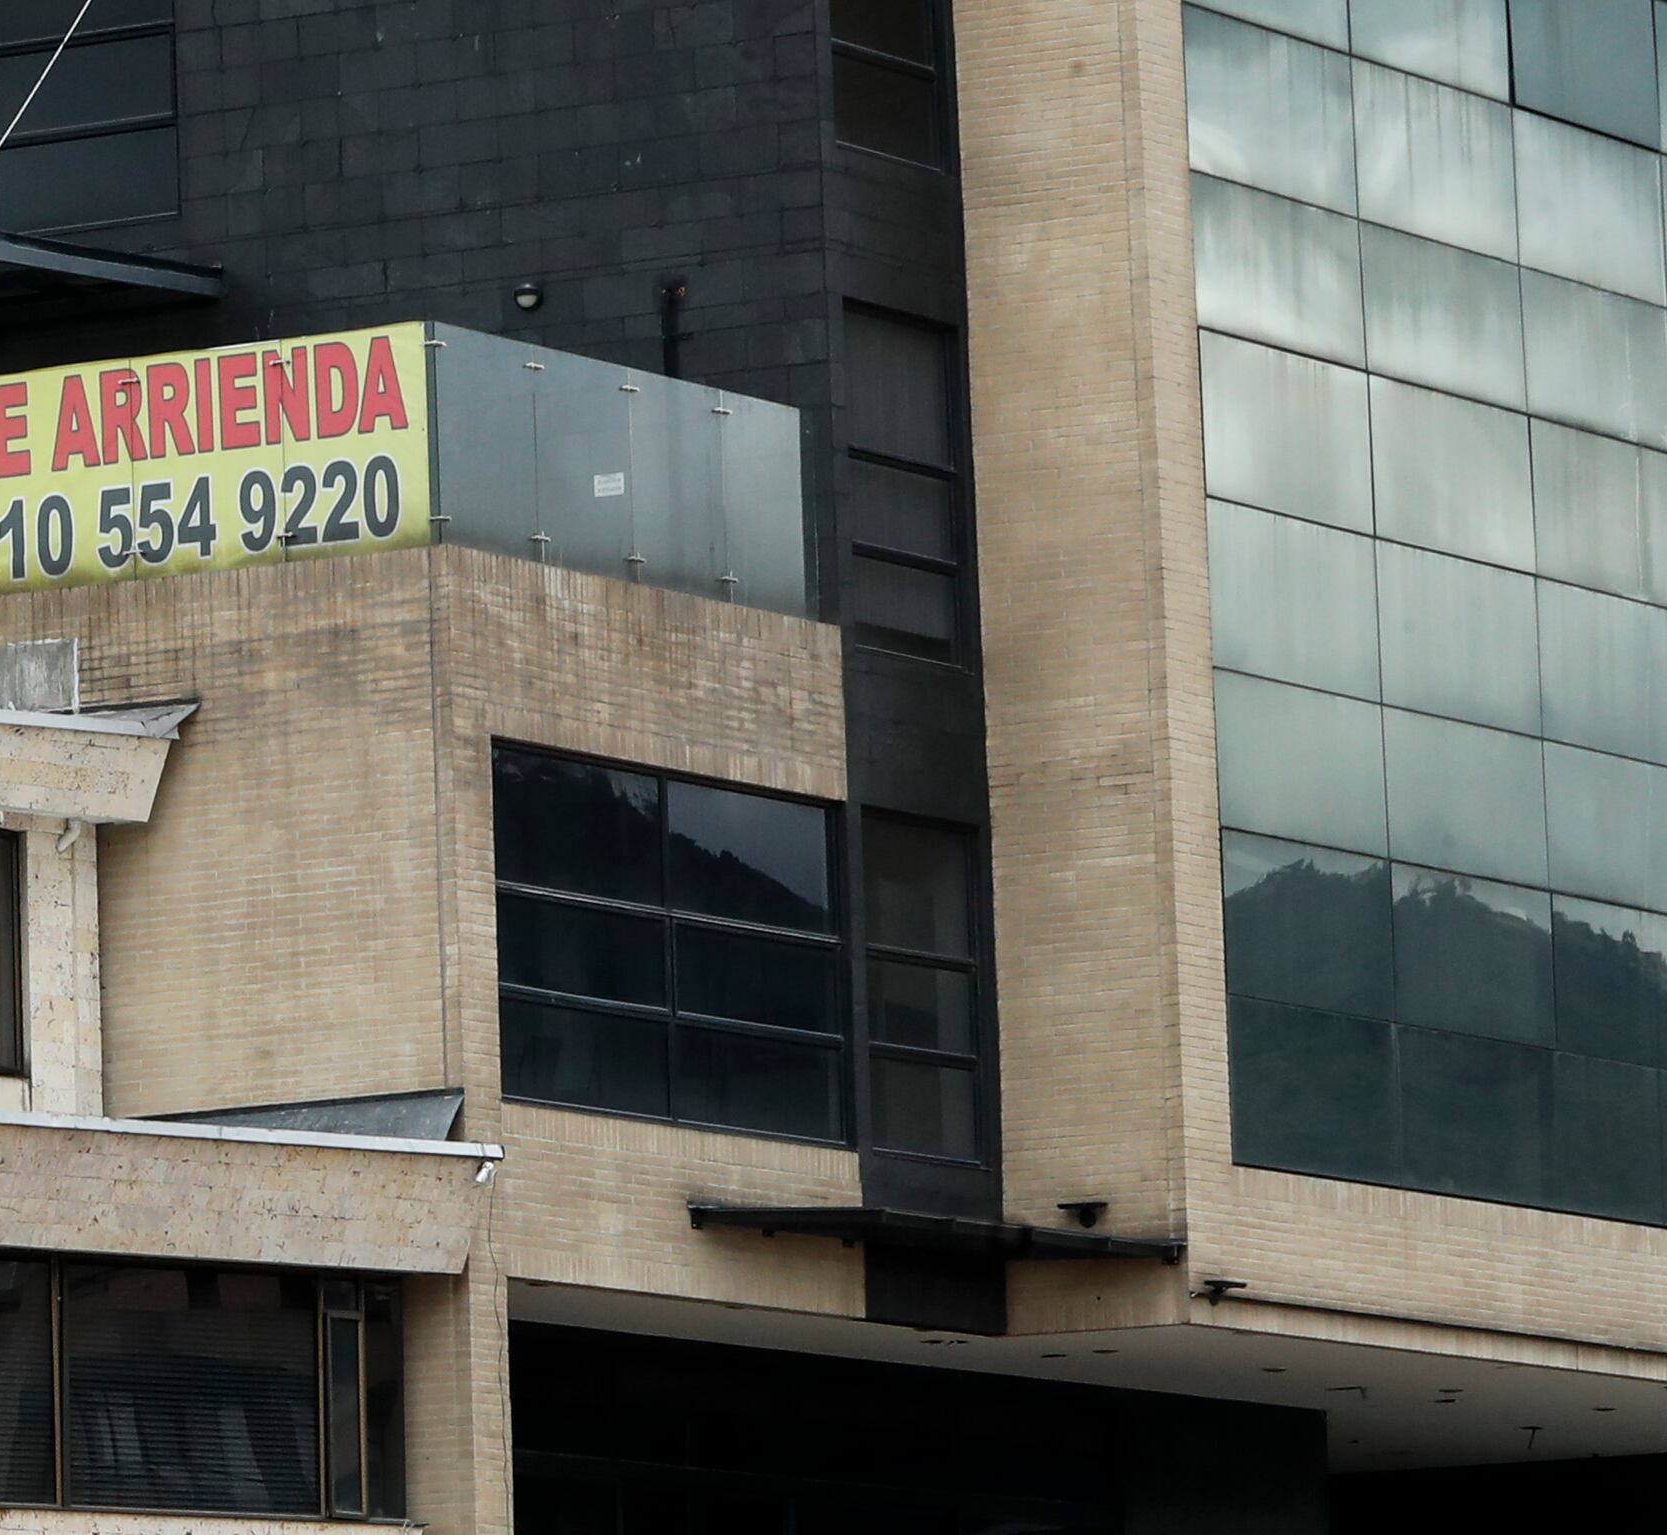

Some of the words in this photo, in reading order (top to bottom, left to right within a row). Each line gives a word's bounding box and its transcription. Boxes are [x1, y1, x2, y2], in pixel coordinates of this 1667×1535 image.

[51, 335, 409, 472] ARRIENDA
[96, 475, 219, 570] 554
[239, 455, 402, 553] 9220
